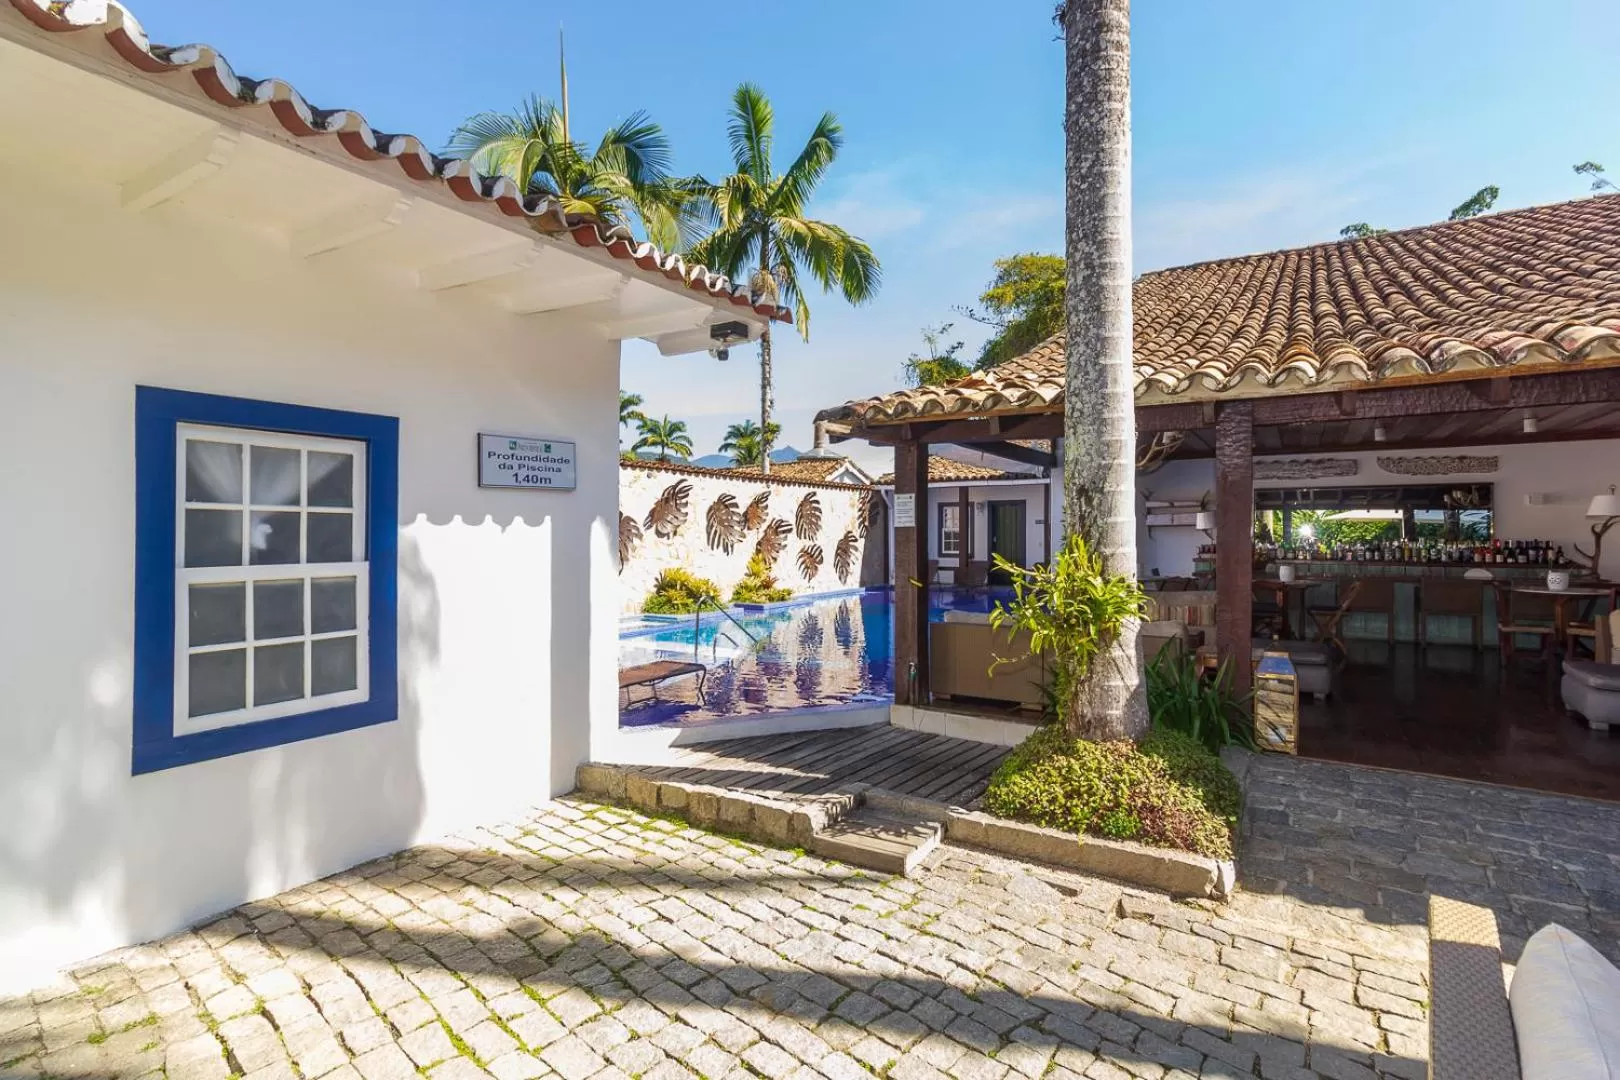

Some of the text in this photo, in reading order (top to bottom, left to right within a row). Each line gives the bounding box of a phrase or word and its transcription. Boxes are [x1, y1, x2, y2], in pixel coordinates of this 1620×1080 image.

[487, 451, 570, 464] Profundidade
[498, 462, 562, 473] da Piscina
[512, 473, 552, 485] 1,40m
